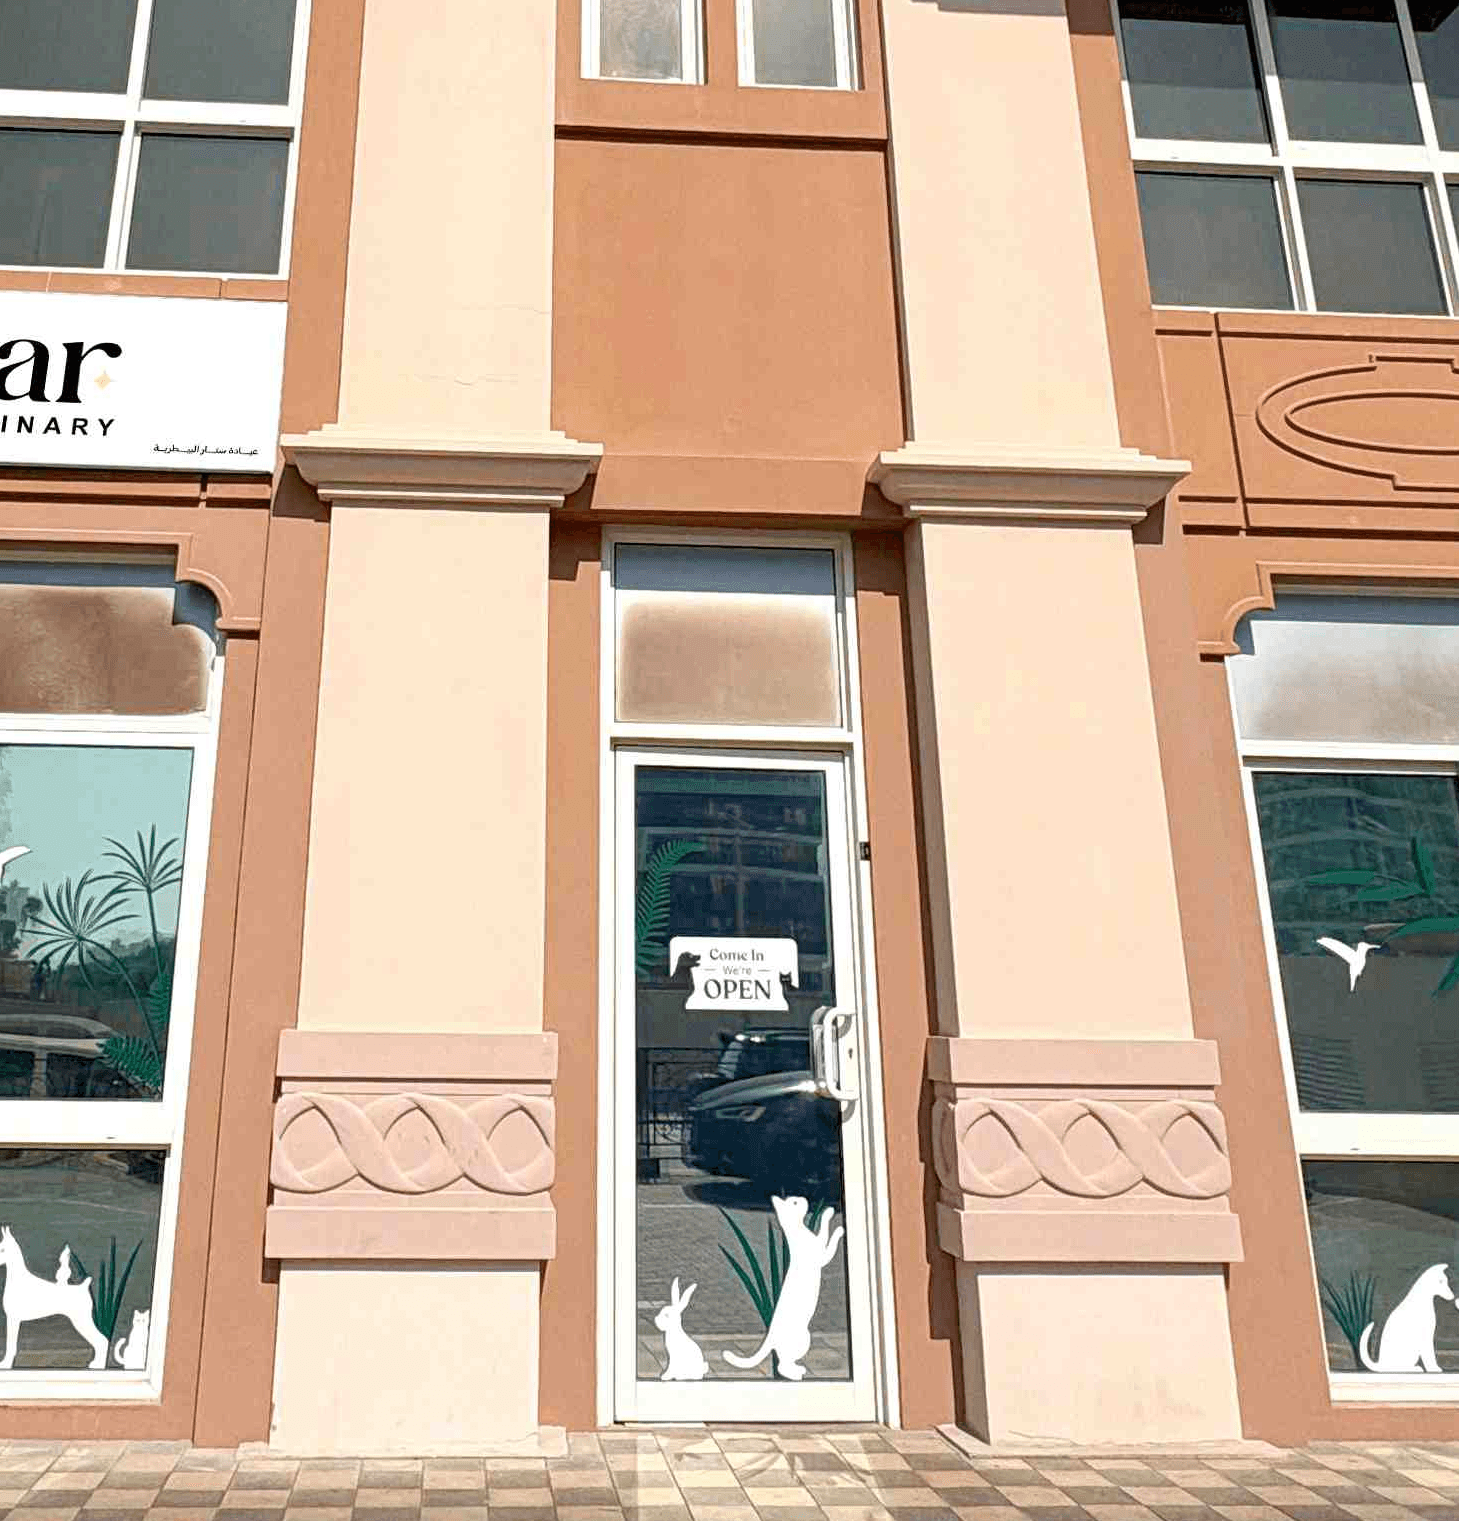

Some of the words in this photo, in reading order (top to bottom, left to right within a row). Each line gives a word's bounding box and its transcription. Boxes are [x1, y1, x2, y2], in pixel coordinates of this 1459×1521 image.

[199, 445, 227, 456] ستار
[228, 446, 259, 456] عيادة
[709, 949, 748, 961] Come
[751, 949, 765, 961] In
[722, 965, 752, 976] We're
[703, 978, 771, 1000] OPEN
